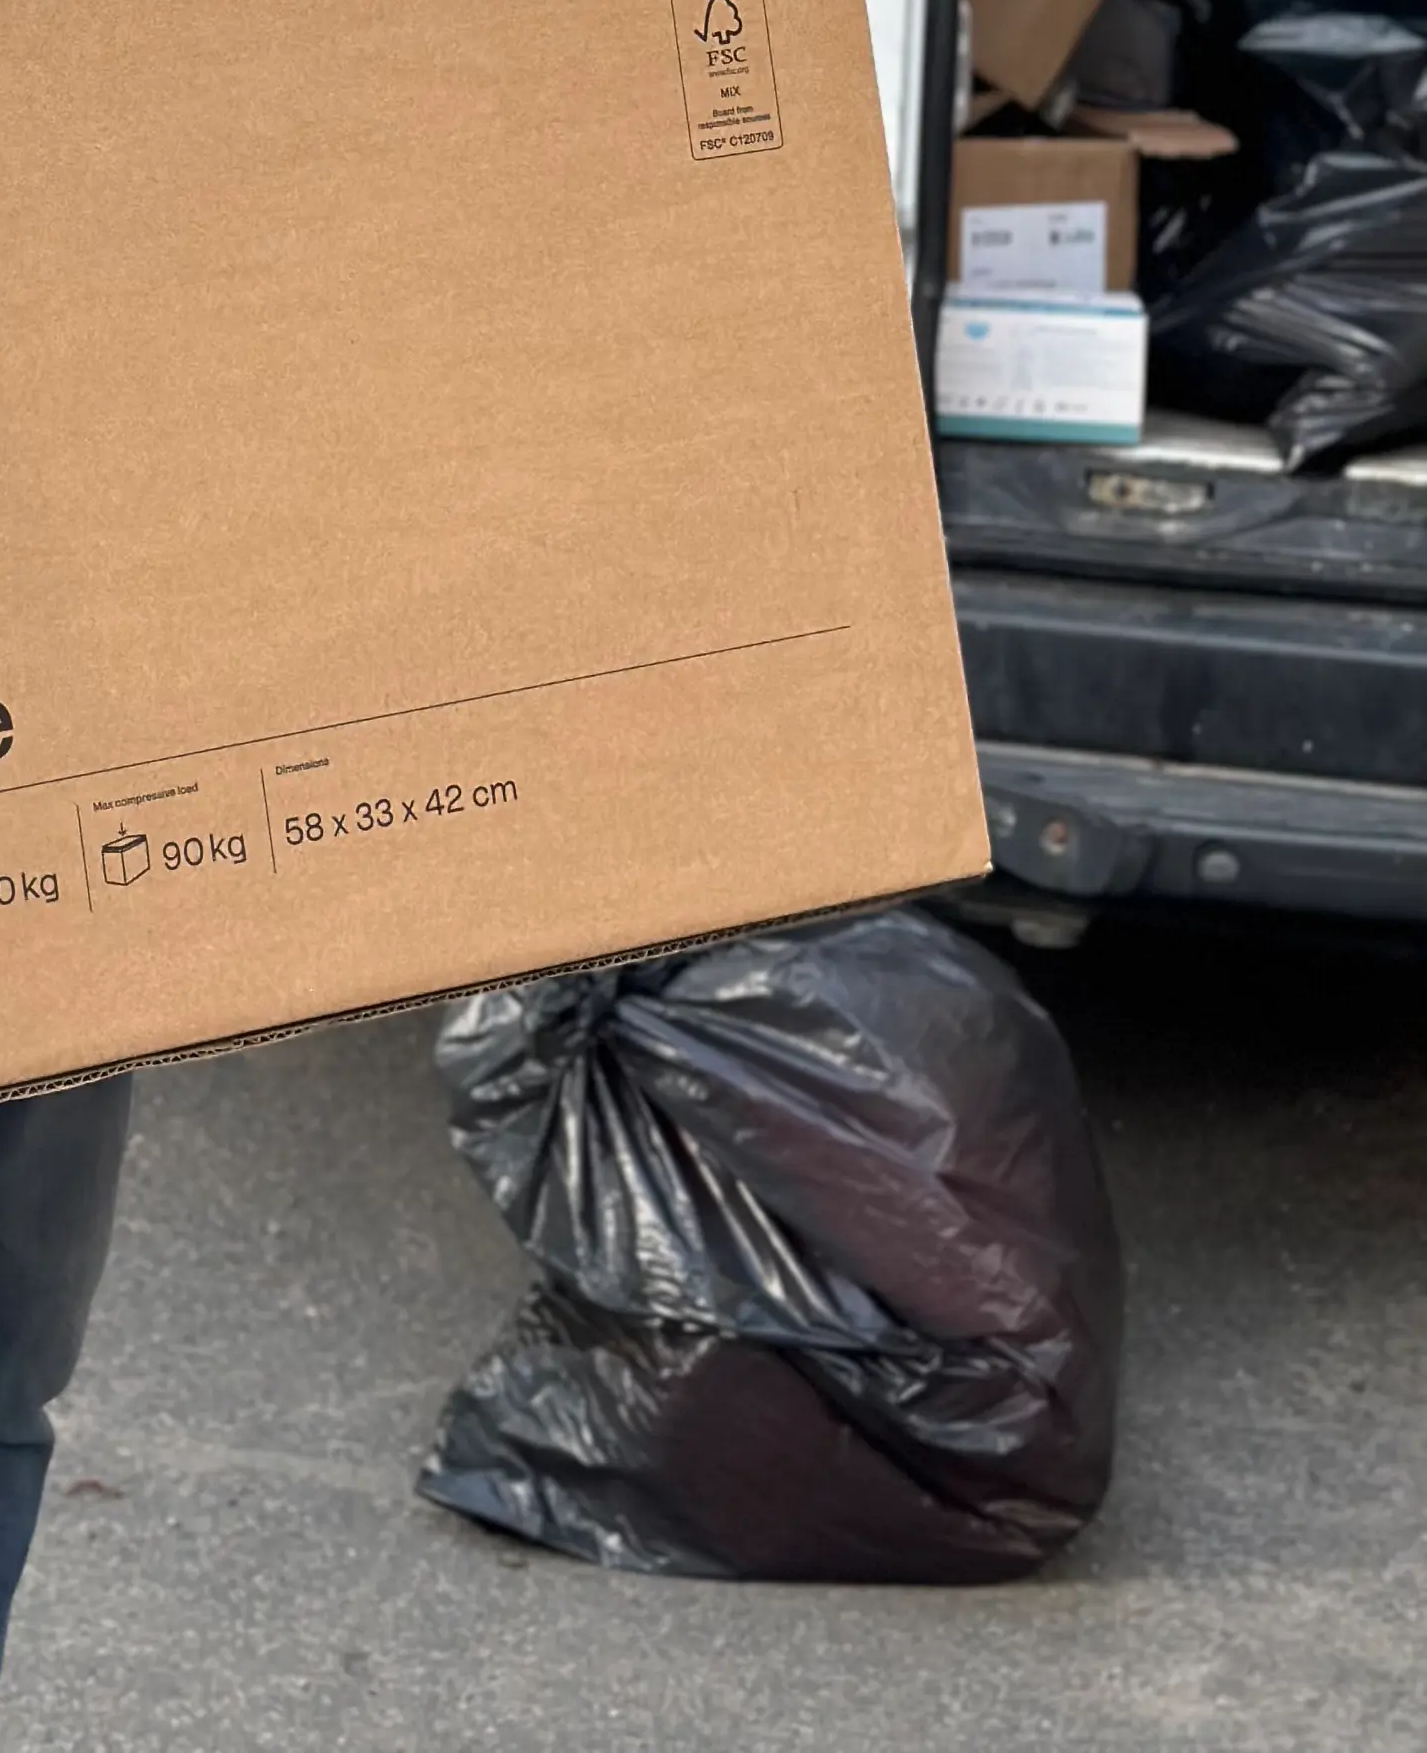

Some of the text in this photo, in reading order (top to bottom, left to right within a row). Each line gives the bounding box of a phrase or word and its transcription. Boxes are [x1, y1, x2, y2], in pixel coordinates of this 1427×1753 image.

[706, 46, 748, 66] FSC
[720, 86, 742, 98] MIX
[285, 780, 518, 846] 58 x 33 x 42 cm
